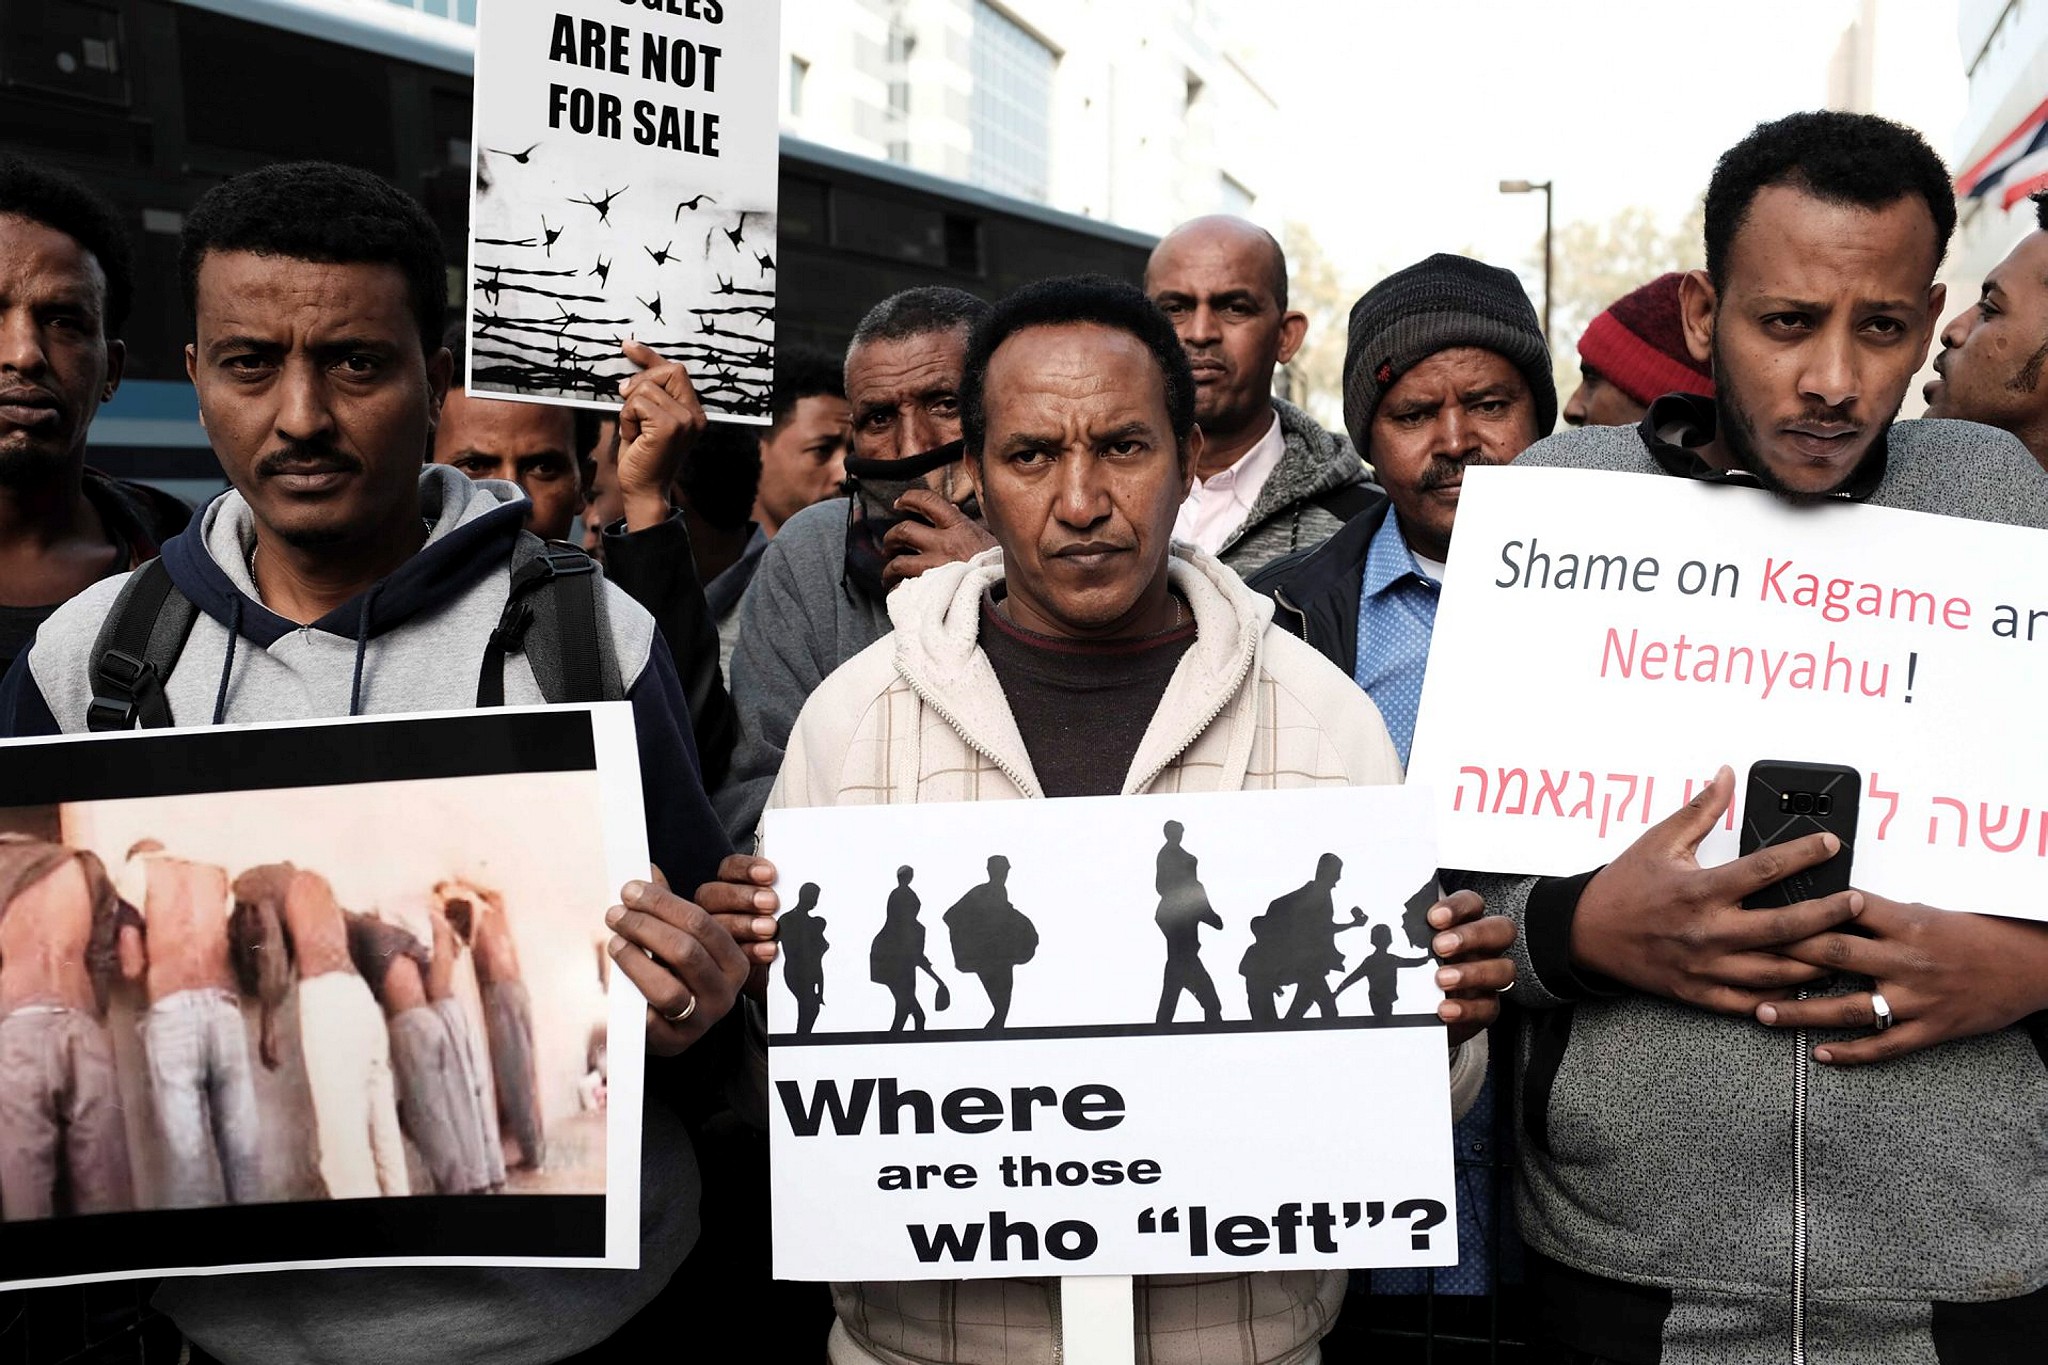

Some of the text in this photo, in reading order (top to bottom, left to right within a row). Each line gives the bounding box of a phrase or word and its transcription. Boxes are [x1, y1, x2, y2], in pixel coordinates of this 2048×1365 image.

[549, 13, 722, 92] ARE NOT
[549, 83, 719, 157] FOR SALE
[1496, 538, 1660, 592] Shame
[1678, 561, 1740, 598] on
[1761, 558, 1972, 630] Kagame
[1454, 766, 1655, 838] וקגאמה
[775, 1078, 1126, 1136] Where
[878, 1156, 1162, 1190] are those
[906, 1211, 1099, 1262] who
